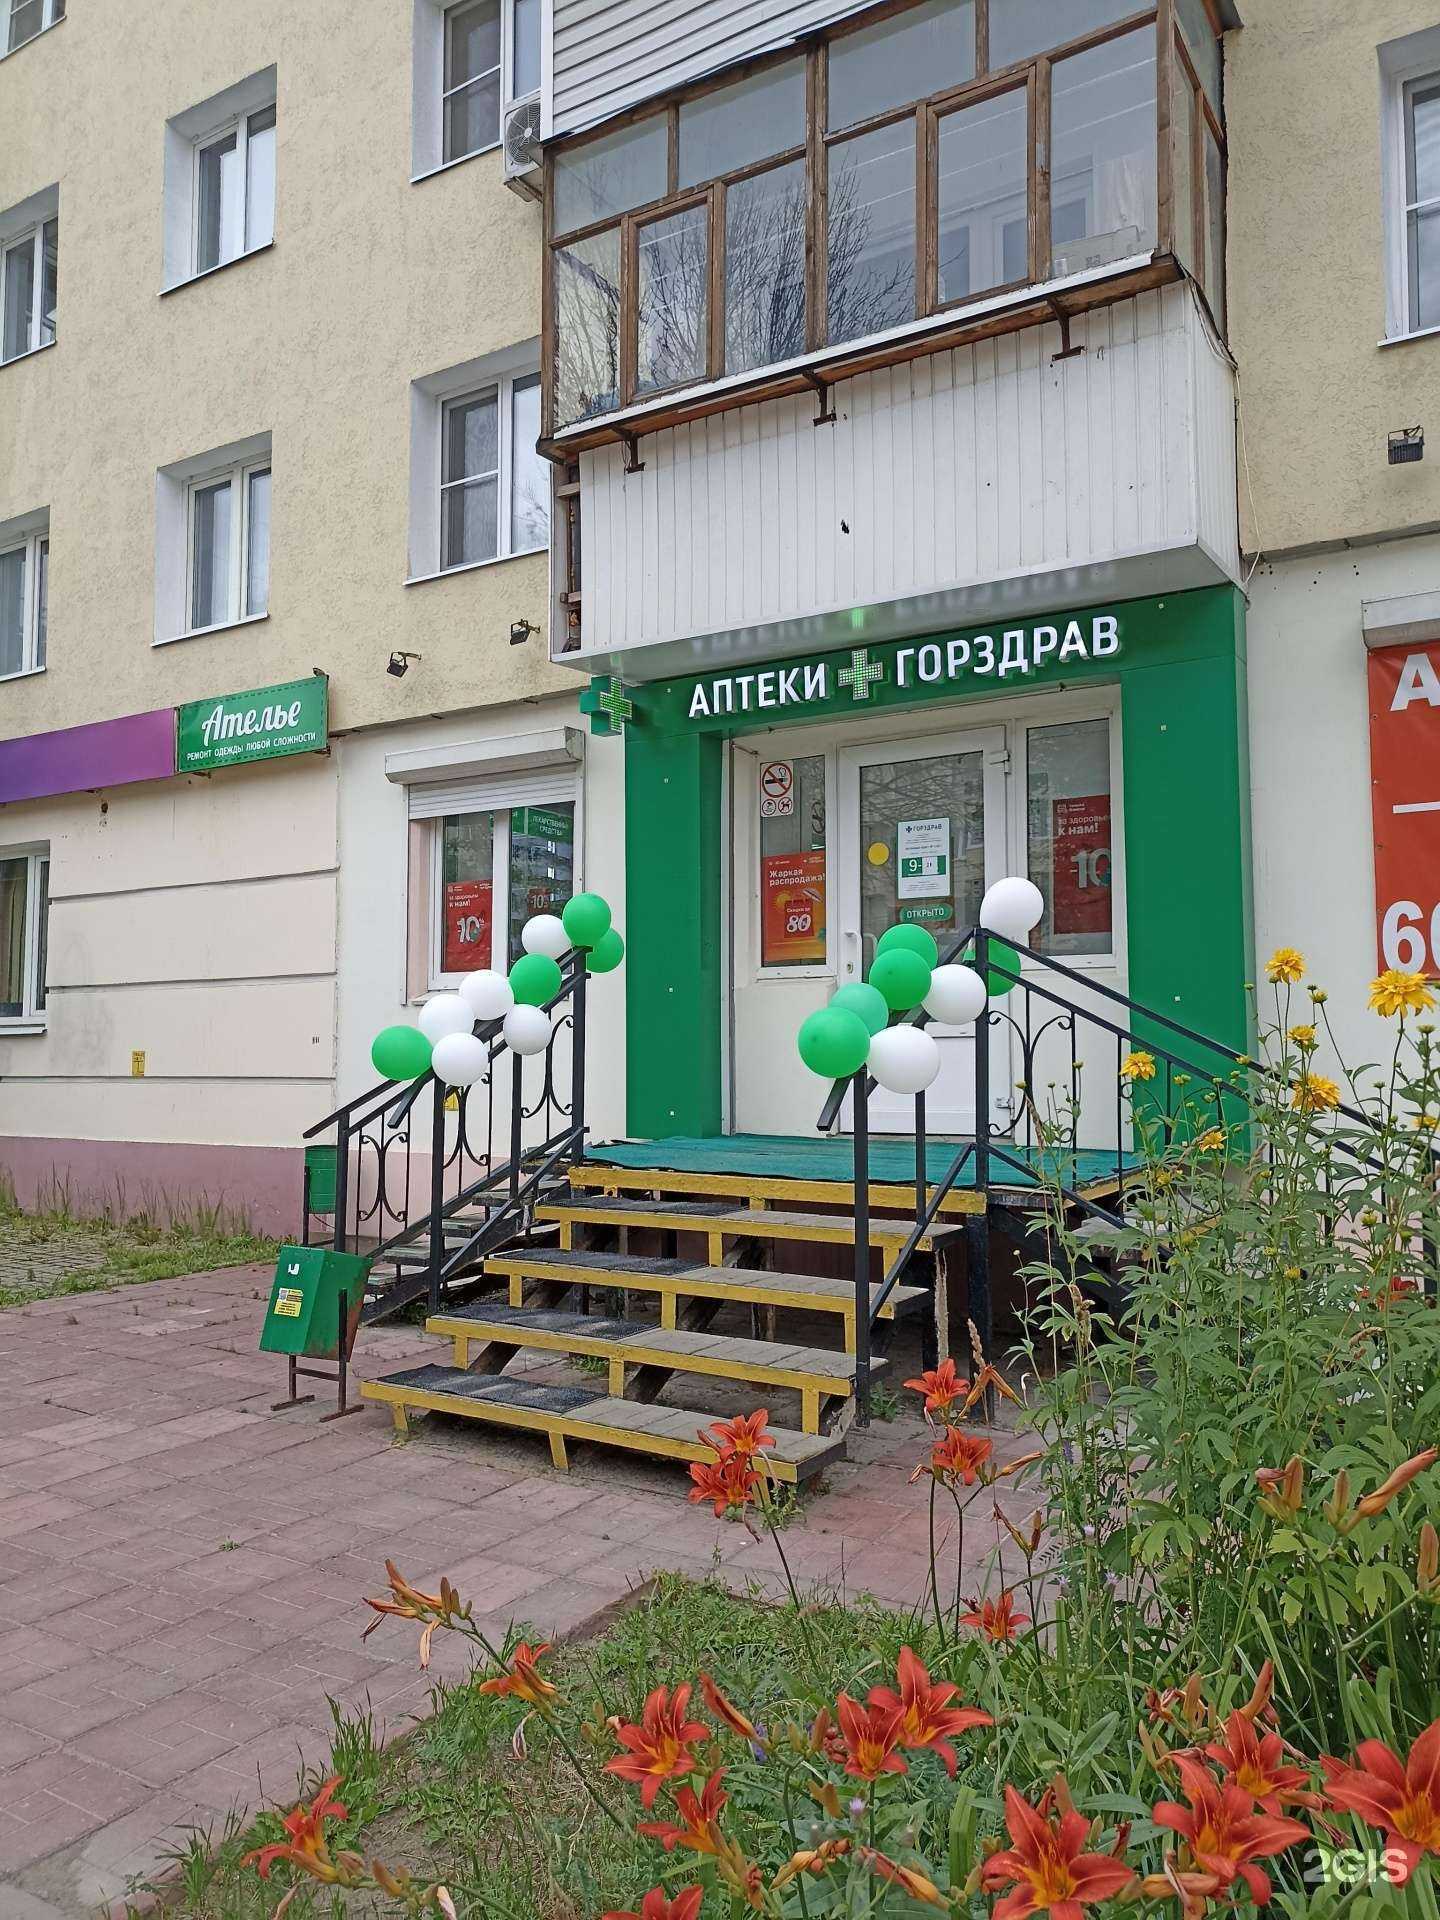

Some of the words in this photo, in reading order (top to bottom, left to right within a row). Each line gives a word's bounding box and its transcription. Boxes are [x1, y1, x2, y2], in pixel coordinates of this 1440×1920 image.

[688, 662, 828, 719] АПТЕКИ
[896, 616, 1120, 687] ГОРЗДРАВ
[201, 701, 302, 747] Ателье
[187, 749, 212, 761] РЕМОНТ
[214, 745, 244, 757] ОДЕЖДЫ
[246, 738, 271, 751] ЛЮБОЙ
[273, 732, 316, 747] СЛОЖНОСТИ
[1069, 823, 1098, 835] нам!
[769, 869, 803, 879] Жаркая
[769, 872, 825, 888] распродажа!
[906, 910, 945, 919] ОТКРЫТО
[786, 914, 812, 933] 80
